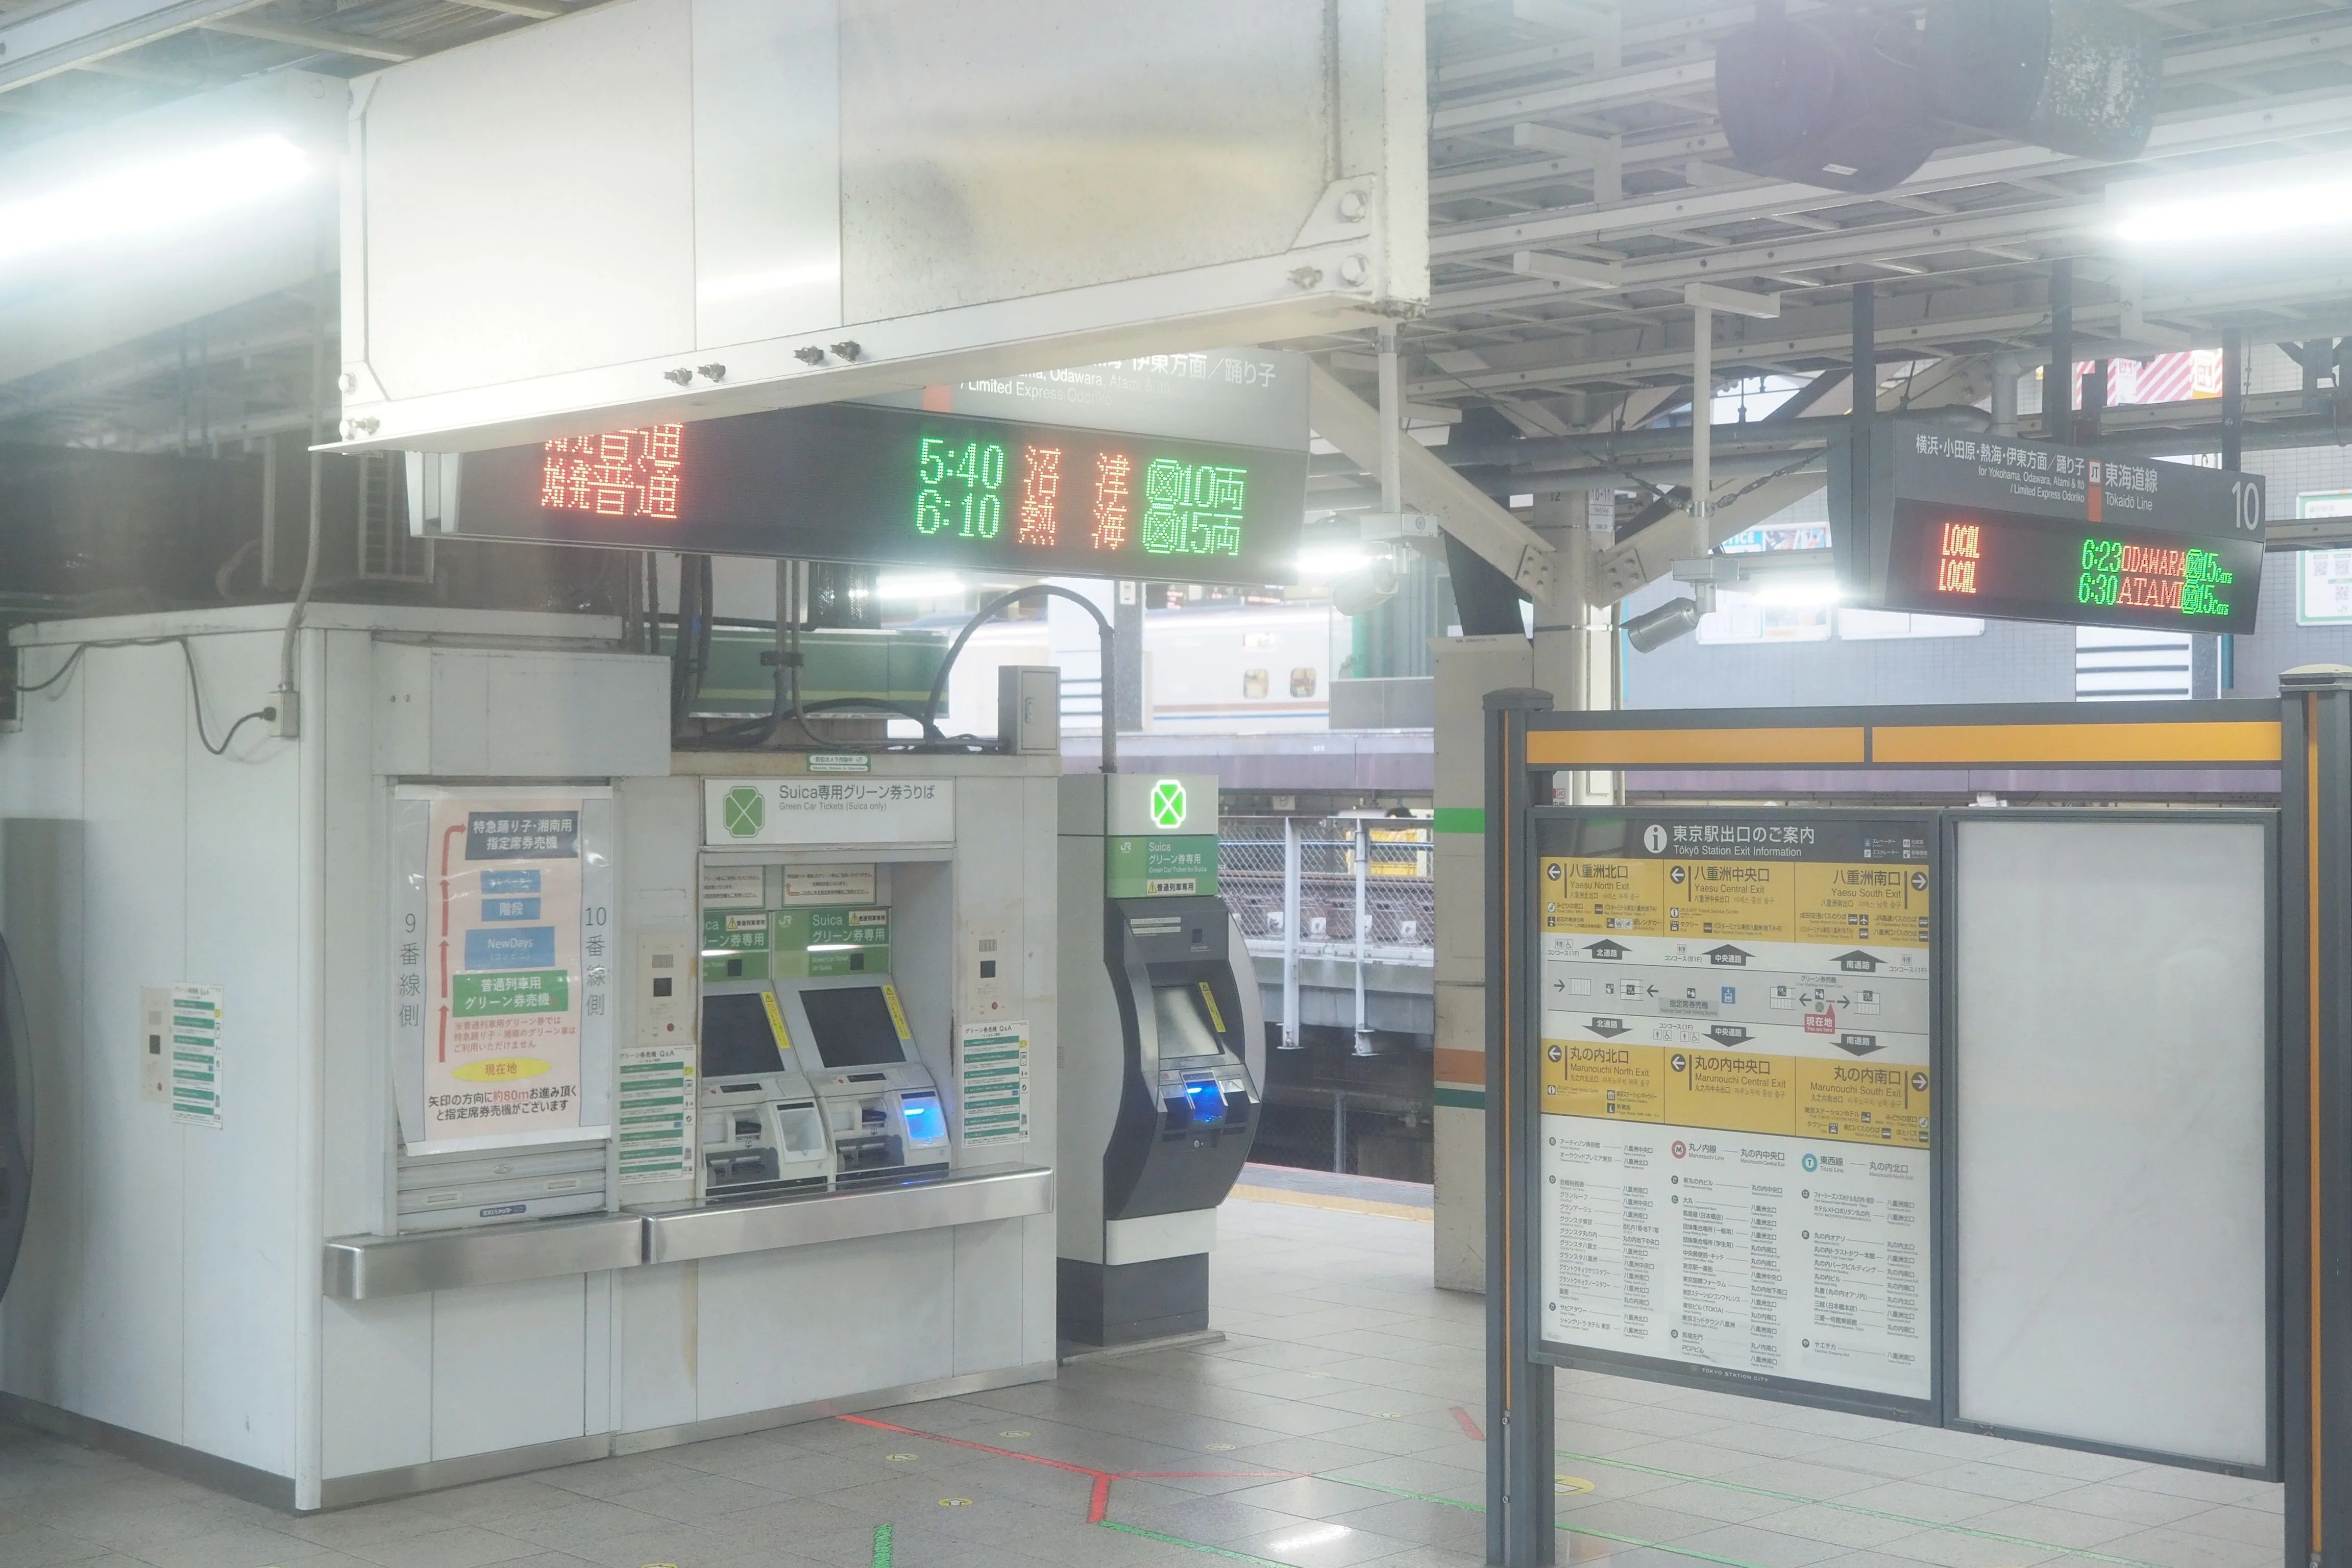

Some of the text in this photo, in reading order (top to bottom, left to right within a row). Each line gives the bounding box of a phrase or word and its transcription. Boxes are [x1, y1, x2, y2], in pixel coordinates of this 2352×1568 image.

[969, 379, 1112, 406] Limited Express Odoriko
[921, 438, 1004, 489] 5:40
[1978, 465, 1987, 475] for
[1989, 467, 2022, 482] Yokohama,
[2023, 472, 2052, 486] Odawara,
[2053, 476, 2070, 487] Atami
[2071, 477, 2075, 488] &
[2105, 462, 2158, 493] 東海道線
[2014, 484, 2085, 503] Limited Express Odoriko
[2105, 492, 2152, 511] Tōkaidō Line
[2232, 481, 2259, 531] 10
[918, 489, 1000, 537] 6:10
[1942, 523, 1980, 558] LOCAL
[2082, 539, 2122, 573] 6:23
[2121, 546, 2186, 577] ODAWARA
[1939, 558, 1976, 593] LOCAL
[2078, 573, 2118, 605] 6:30
[2116, 577, 2184, 608] ATAMI
[779, 784, 935, 800] Suica専用グリーン券うりば
[779, 802, 887, 812] Green Car Tickets (Suica only)
[1673, 824, 1815, 844] 東京駅出口のご案内
[486, 837, 558, 850] 指定席券売機
[1120, 842, 1132, 851] JR
[1149, 842, 1171, 852] Suica
[1674, 845, 1802, 857] Tōkyō Station Exit Information
[1149, 854, 1201, 865] グリーン券専用
[1570, 864, 1628, 878] 八重洲北口
[1695, 866, 1770, 882] 八重洲中央口
[1833, 870, 1901, 886] 八重洲南口
[1157, 883, 1194, 892] 普通列車専用
[1570, 881, 1629, 890] Yaesu North Exit
[1695, 884, 1765, 894] Yaesu Central Exit
[1831, 888, 1901, 898] Yaesu South Exit
[499, 902, 524, 916] 階段
[813, 914, 843, 927] Suica
[704, 933, 764, 947] ーン券専用
[813, 928, 886, 943] グリーン券専用
[487, 938, 533, 949] NewDays
[1597, 949, 1618, 958] 北通路
[1715, 954, 1742, 963] 中央通路
[399, 913, 420, 1027] 9番線側
[1846, 961, 1870, 969] 南通路
[481, 976, 542, 992] 普通列車用
[1670, 1000, 1708, 1009] 指定席券売機
[1597, 1019, 1618, 1028] 北通路
[1806, 1017, 1832, 1027] 現在地
[1715, 1028, 1742, 1037] 中央通路
[454, 1040, 536, 1053] ご利用いただけません
[1846, 1037, 1870, 1046] 南通路
[1570, 1046, 1629, 1064] 丸の内北口
[484, 1062, 518, 1076] 現在地
[1570, 1063, 1649, 1077] Marunouchi North Exit
[1695, 1055, 1770, 1075] 丸の内中央口
[1695, 1072, 1785, 1088] Marunouchi Central Exit
[1834, 1066, 1901, 1085] 丸の内南口
[428, 1085, 576, 1107] 矢印の方向に約80mお進み頂く
[1811, 1082, 1901, 1097] Marunouchi South Exit
[436, 1099, 569, 1121] と指定席券売機がございます
[1804, 1107, 1860, 1117] 東京ステーションホテル
[1885, 1114, 1917, 1122] みどりの窓口
[1688, 1143, 1717, 1154] 丸ノ内線
[1741, 1148, 1785, 1161] 丸の内中央口
[1820, 1156, 1843, 1166] 東西線
[1869, 1161, 1908, 1173] 丸の内北口
[1683, 1177, 1713, 1186] 新丸の内ビル
[1560, 1216, 1592, 1225] グランスタ東京
[1560, 1228, 1598, 1238] グランスタ丸の内
[1814, 1273, 1841, 1282] 丸の内ビル
[1560, 1305, 1587, 1313] サピアタワー
[1682, 1345, 1704, 1353] PCPビル
[1815, 1341, 1836, 1350] ヤエチカ
[1725, 1371, 1751, 1380] STATION
